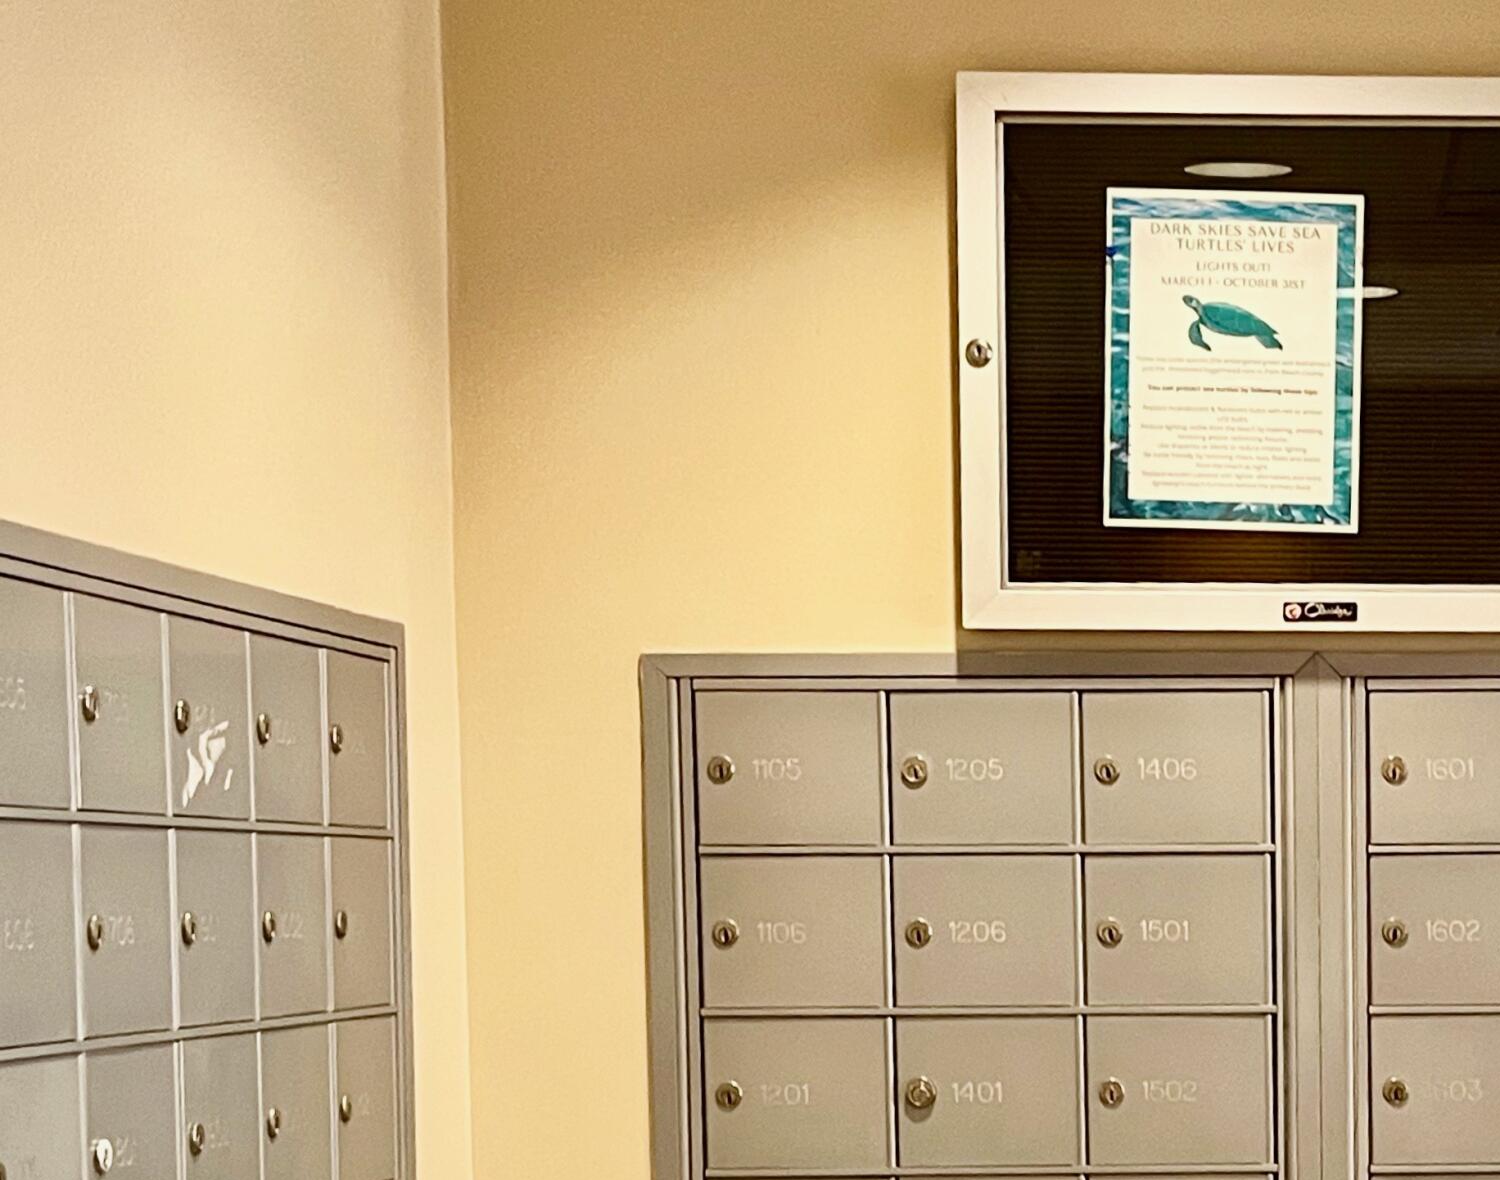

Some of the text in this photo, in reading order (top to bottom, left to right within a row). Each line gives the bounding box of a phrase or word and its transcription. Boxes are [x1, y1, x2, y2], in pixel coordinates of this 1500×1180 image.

[1150, 222, 1321, 240] DARK SKIES SAVE SEA
[1252, 240, 1295, 253] LIVES
[1196, 261, 1239, 272] LIGHTS
[1161, 276, 1206, 287] MARCH
[1223, 277, 1278, 288] OCTOBER
[751, 758, 802, 782] 1105
[944, 757, 1005, 782] 1205
[1137, 757, 1197, 782] 1406
[1425, 757, 1475, 782] 1601
[757, 921, 807, 946] 1106
[948, 921, 1007, 944] 1206
[1138, 920, 1190, 944] 1501
[1425, 919, 1481, 943] 1602
[759, 1083, 811, 1106] 1201
[951, 1081, 1003, 1104] 1401
[1141, 1081, 1198, 1104] 1502
